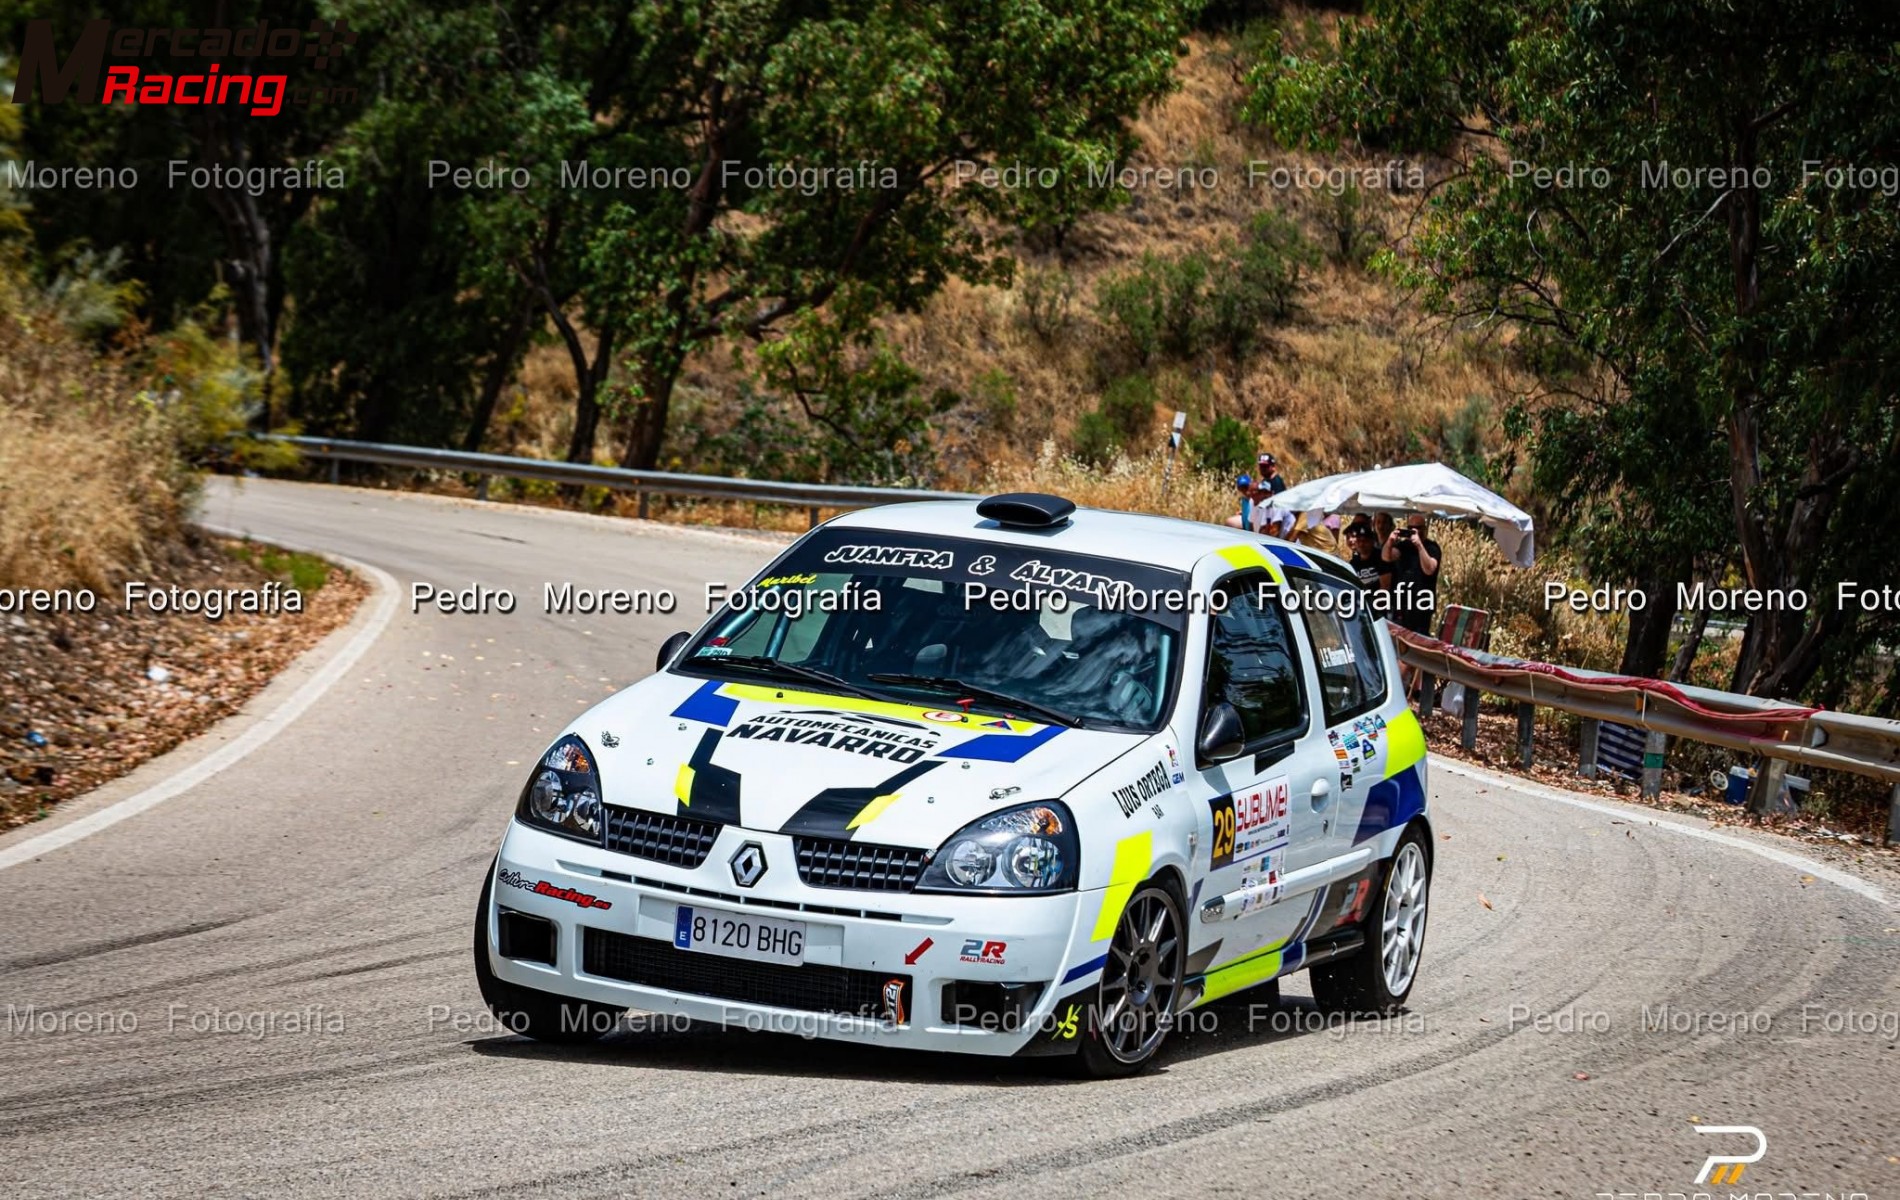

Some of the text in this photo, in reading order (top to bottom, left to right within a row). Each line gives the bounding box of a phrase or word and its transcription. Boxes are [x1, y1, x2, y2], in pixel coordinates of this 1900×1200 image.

[824, 545, 954, 569] JUANFRA
[968, 555, 996, 575] &
[726, 724, 926, 764] NAVARRO
[751, 715, 939, 749] AUTOMECANICAS
[1112, 761, 1172, 819] LUIS ORTEGA
[1213, 806, 1236, 859] 29
[680, 931, 688, 941] E
[692, 916, 803, 957] 8120 BHG
[961, 939, 1007, 960] 2R
